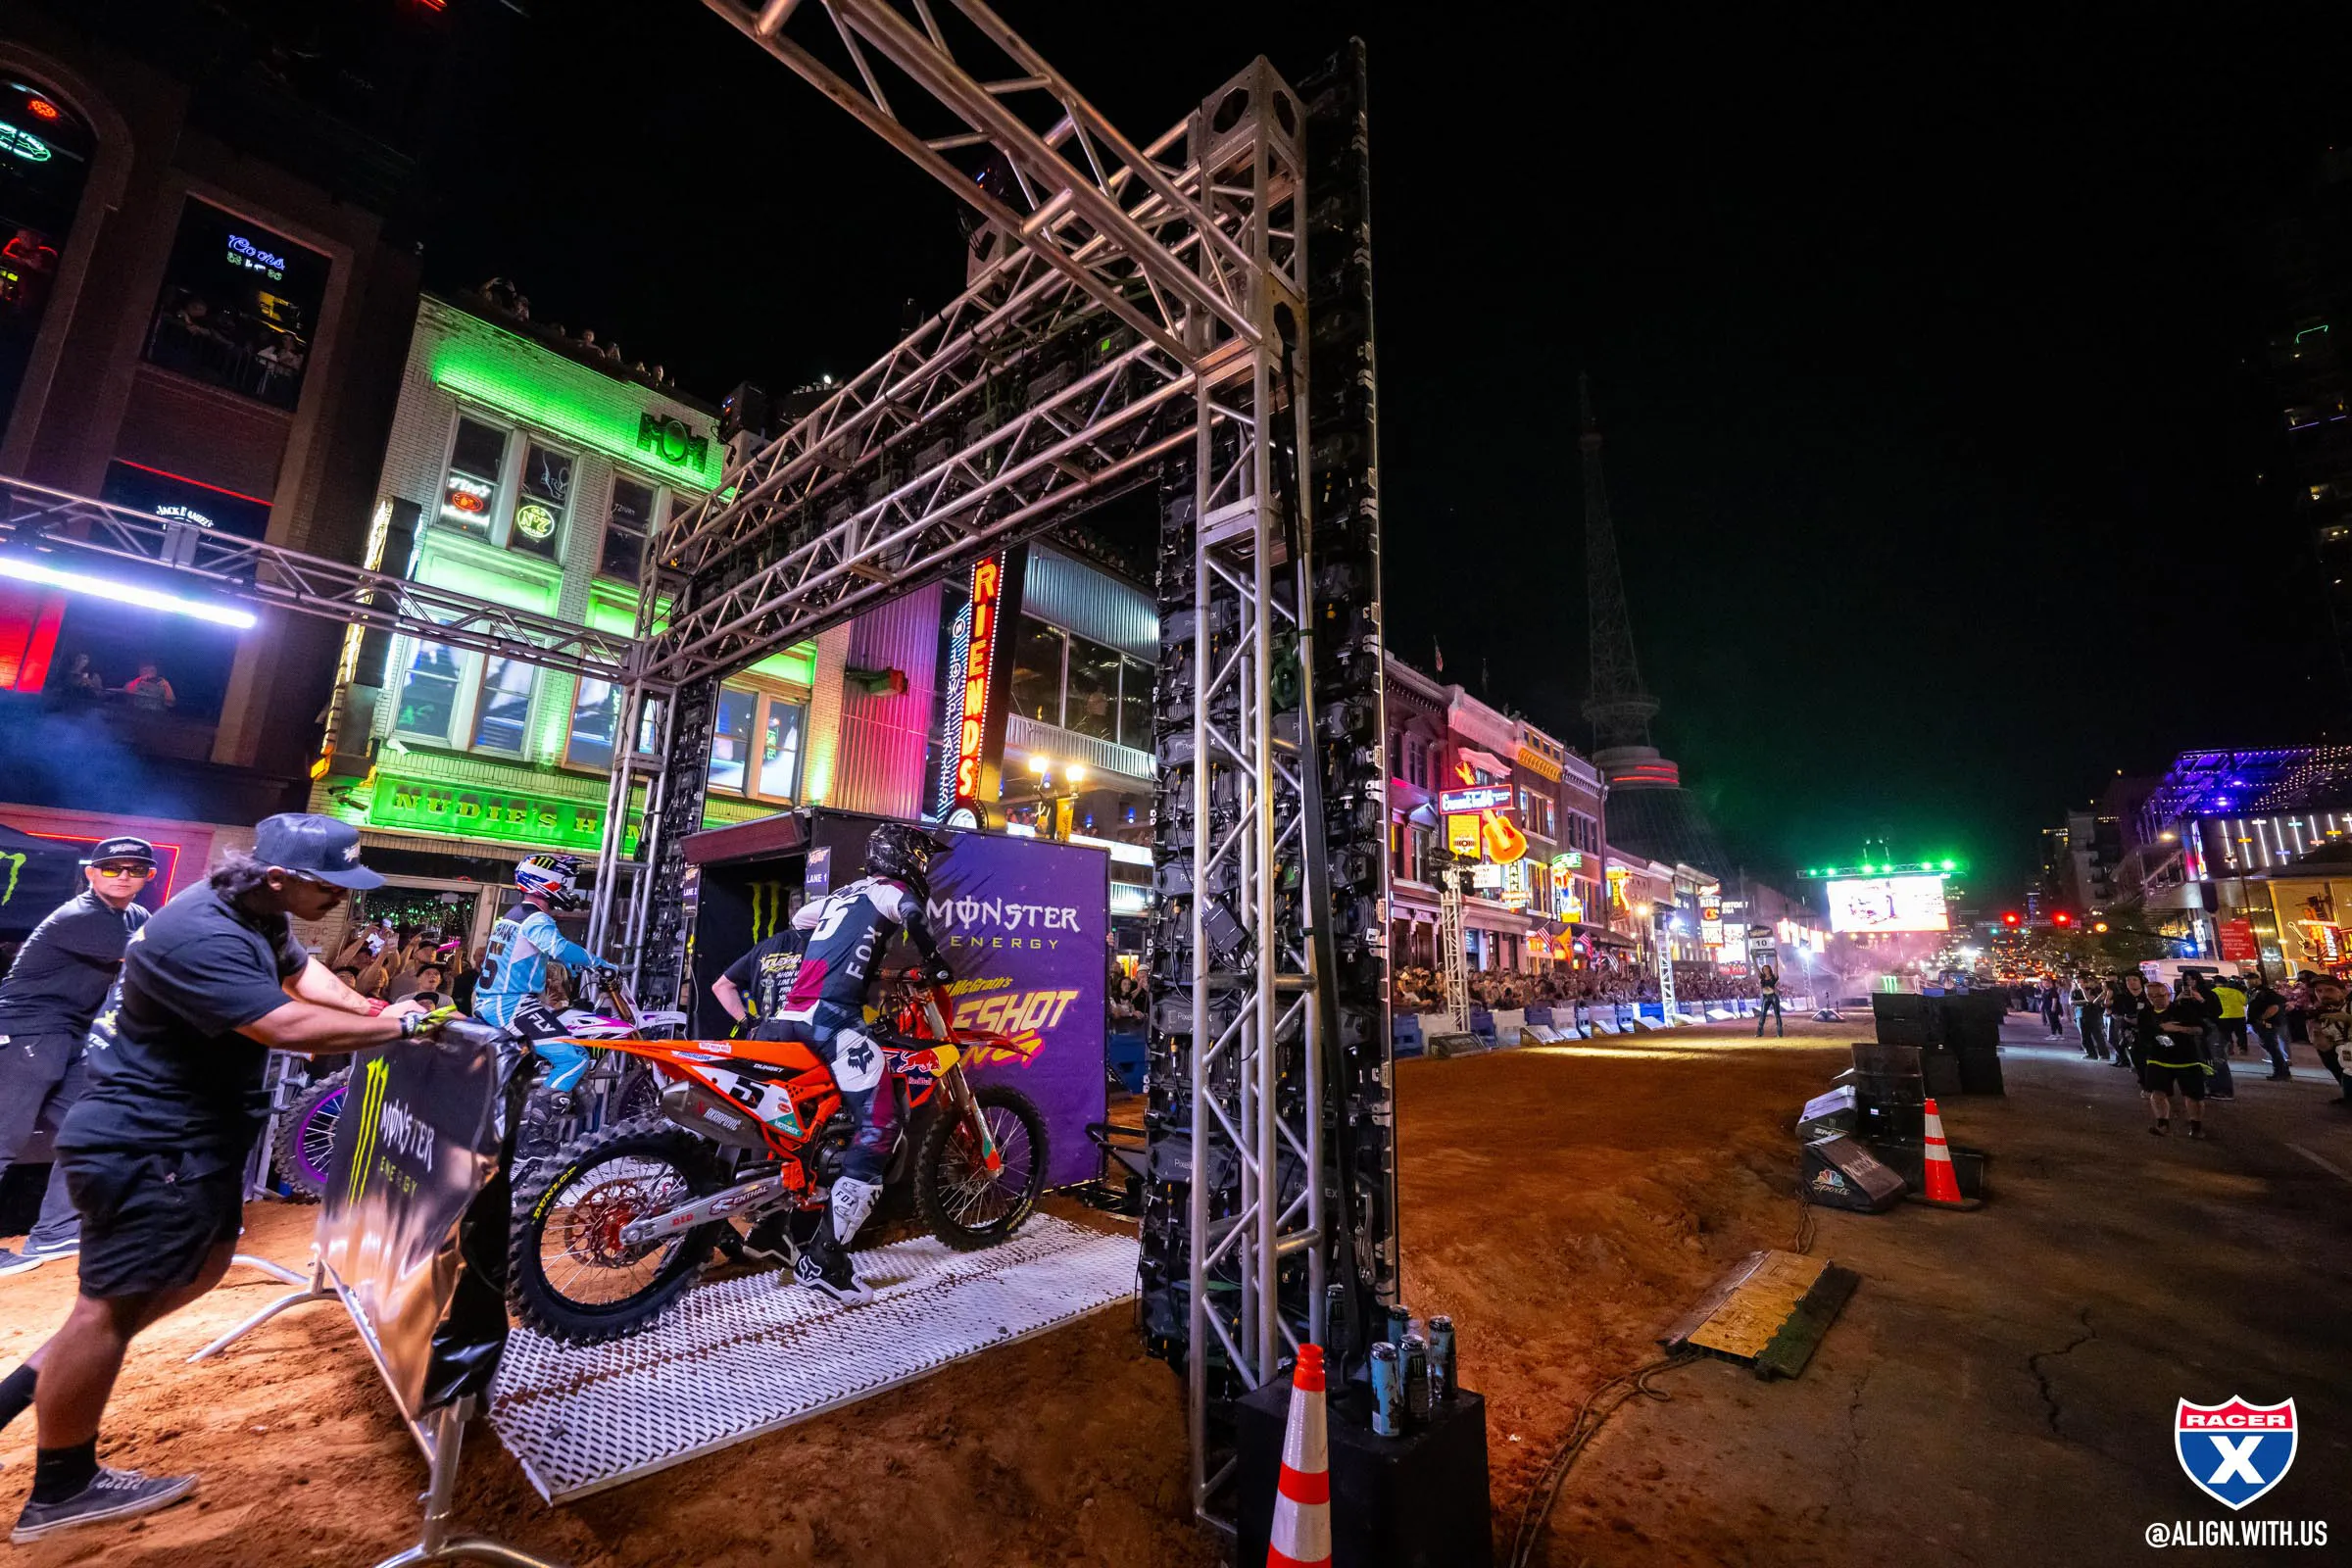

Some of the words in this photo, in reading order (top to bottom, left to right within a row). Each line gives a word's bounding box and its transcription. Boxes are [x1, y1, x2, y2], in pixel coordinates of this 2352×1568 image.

[228, 235, 285, 270] Coors
[156, 505, 180, 515] JACK
[958, 560, 997, 798] RIENDS
[394, 793, 558, 829] NUDIE'S
[807, 874, 822, 883] LANE
[809, 895, 859, 941] 5
[926, 895, 1081, 932] MONSTER
[846, 925, 882, 980] FOX
[951, 936, 1058, 950] ENERGY
[950, 977, 1013, 997] McGrath's
[528, 1013, 556, 1032] FLY
[729, 1076, 771, 1109] 5
[380, 1098, 435, 1173] MONSTER
[379, 1155, 418, 1199] ENERGY
[1812, 1179, 1850, 1197] Sports
[835, 1190, 856, 1207] FOX
